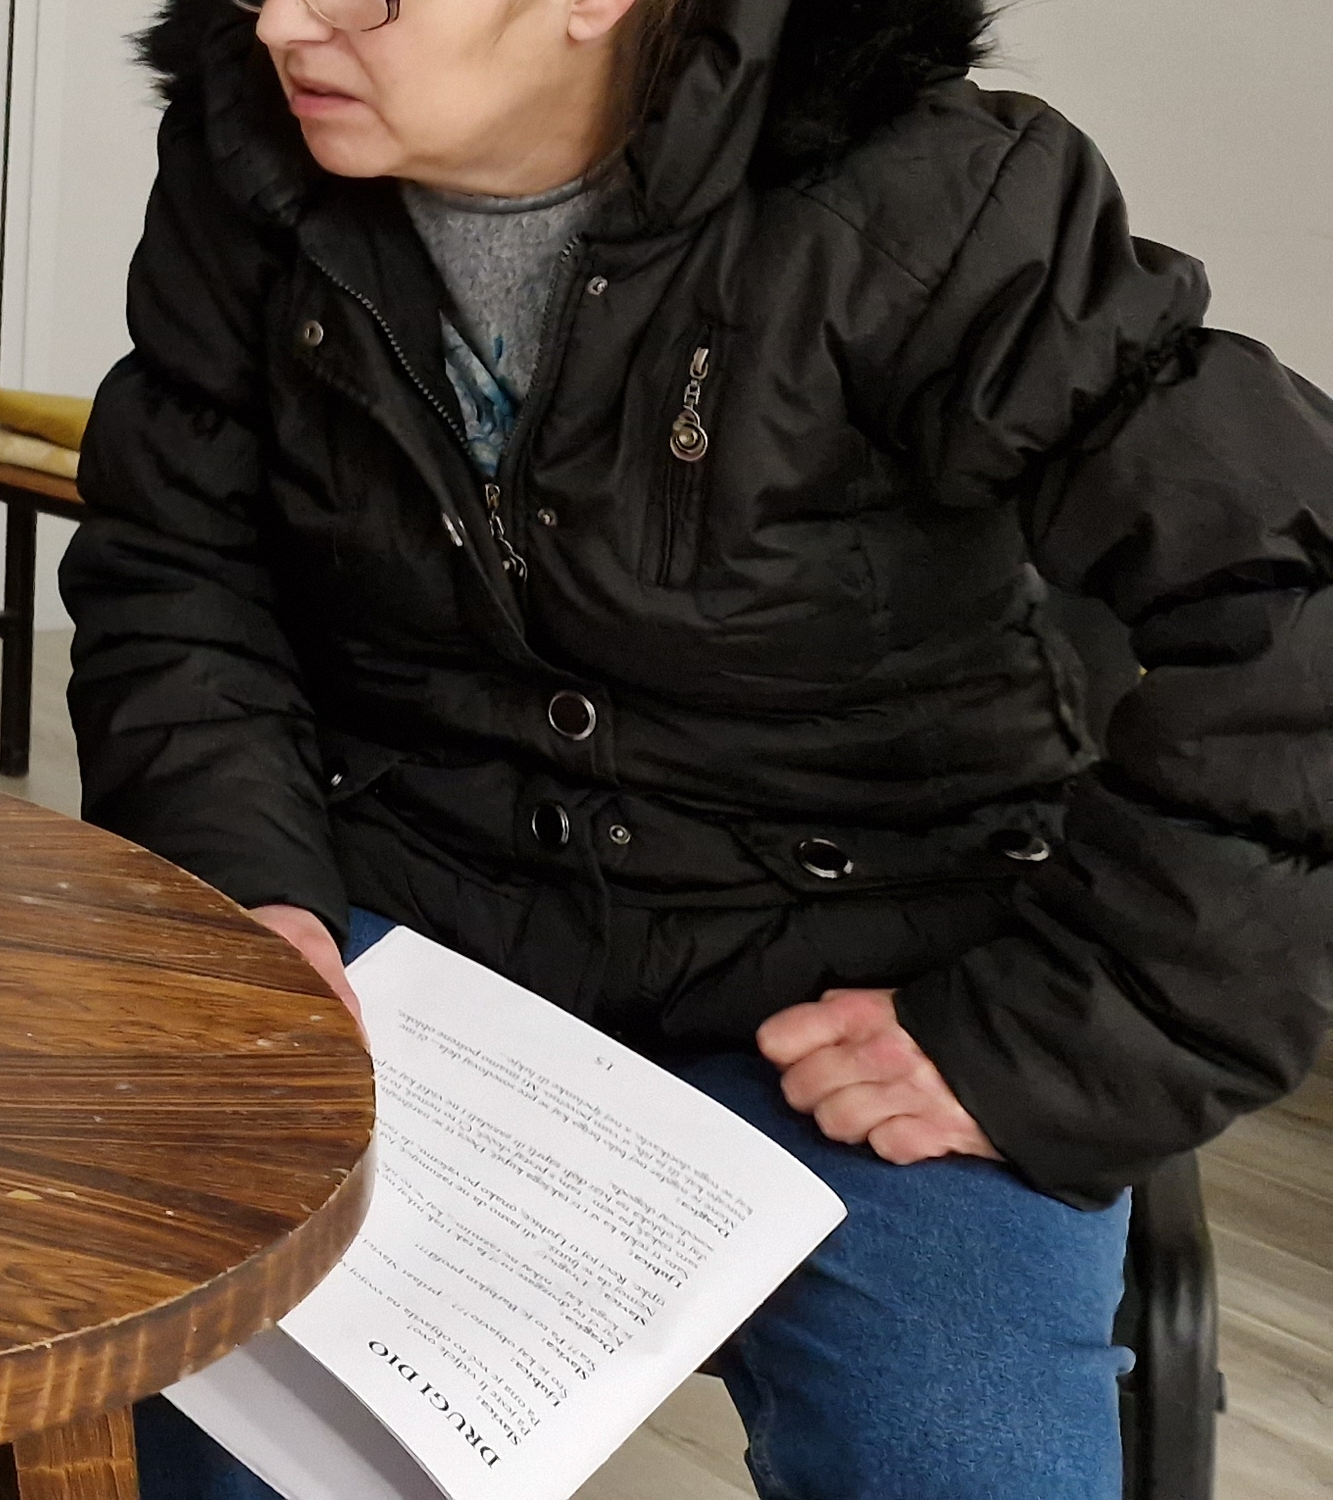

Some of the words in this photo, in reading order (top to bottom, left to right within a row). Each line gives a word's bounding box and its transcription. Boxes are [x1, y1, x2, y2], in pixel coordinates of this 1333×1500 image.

[385, 1295, 401, 1308] na
[465, 1274, 518, 1312] Barbikin
[403, 1307, 451, 1342] objavila
[405, 1323, 436, 1345] ovo!
[550, 1330, 566, 1345] Pa
[367, 1340, 419, 1382] DIO
[438, 1344, 476, 1379] vidjele
[451, 1341, 467, 1355] to
[515, 1346, 536, 1367] kaj
[541, 1337, 590, 1380] Slavica:
[510, 1357, 561, 1407] Ljubica:
[419, 1382, 499, 1467] DRUGI
[475, 1394, 521, 1446] Slavica:
[516, 1417, 531, 1437] Pa
[526, 1407, 541, 1427] Pa
